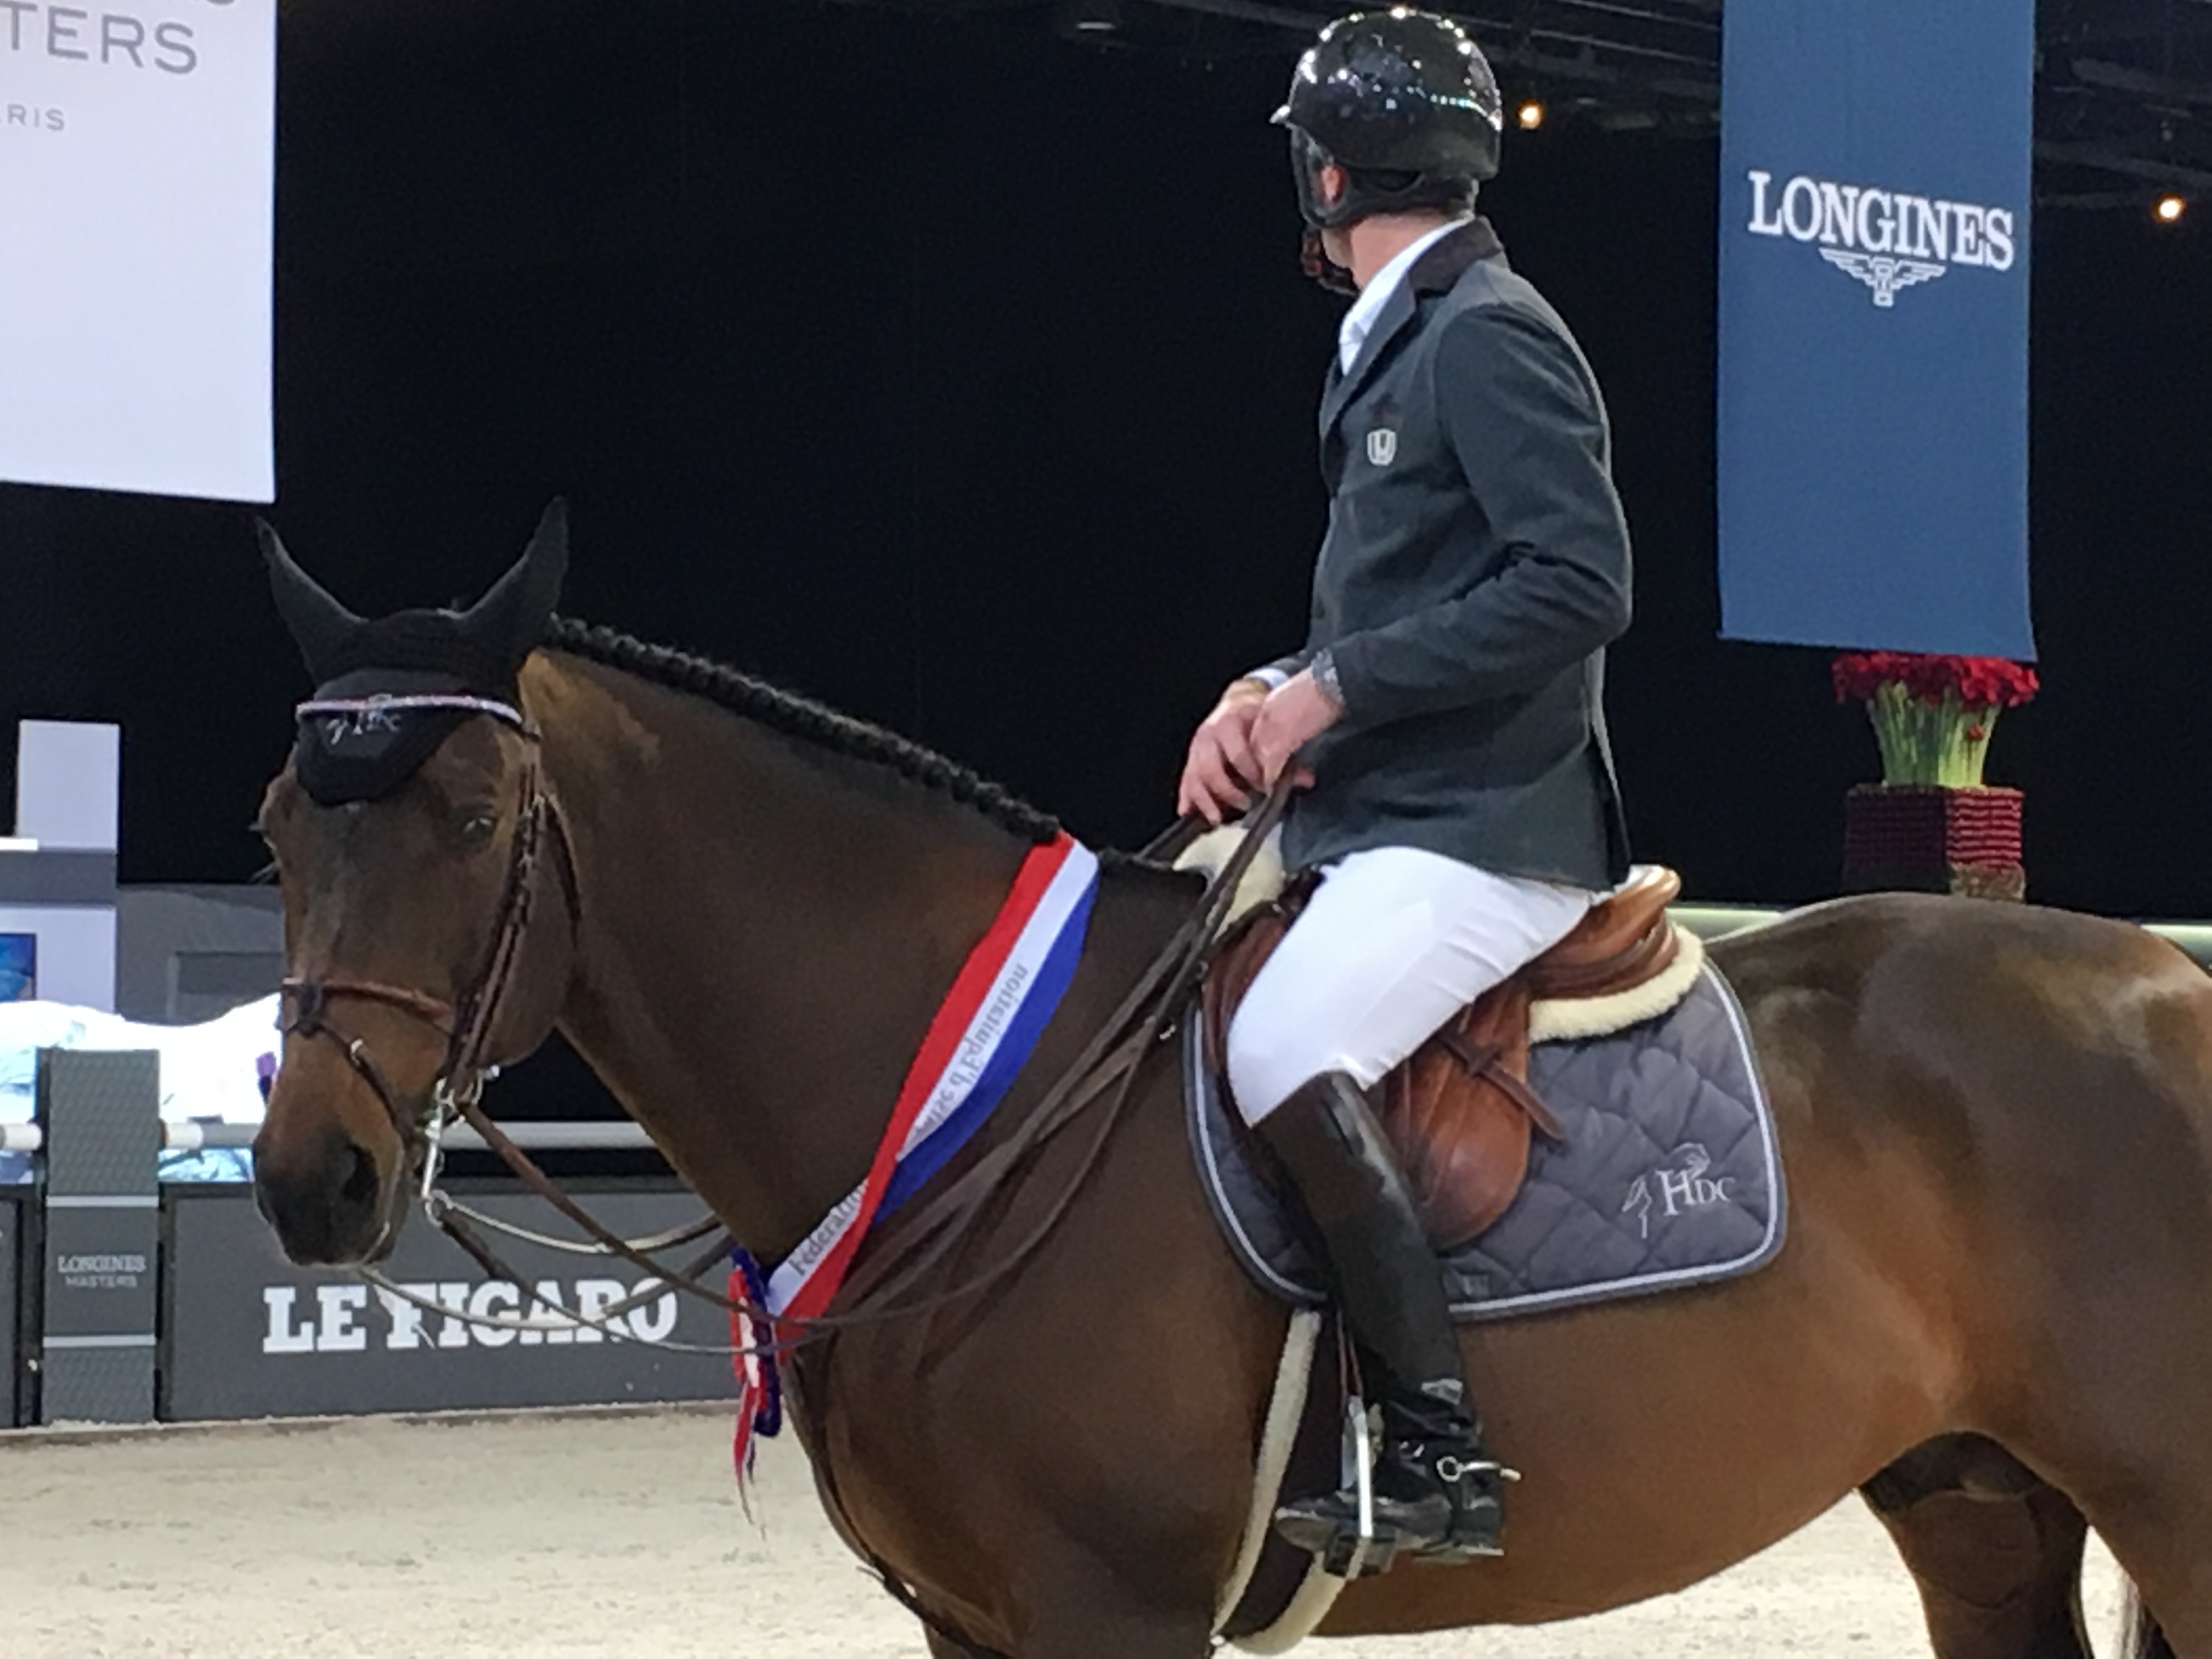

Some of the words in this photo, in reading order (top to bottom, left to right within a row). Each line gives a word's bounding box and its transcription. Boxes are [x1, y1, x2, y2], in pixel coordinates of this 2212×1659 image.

[0, 103, 65, 131] RIS
[1747, 170, 2014, 271] LONGINES
[58, 1255, 145, 1272] LONGINES
[65, 1276, 137, 1288] MASTERS
[263, 1285, 366, 1353] LE
[385, 1277, 678, 1348] FIGARO
